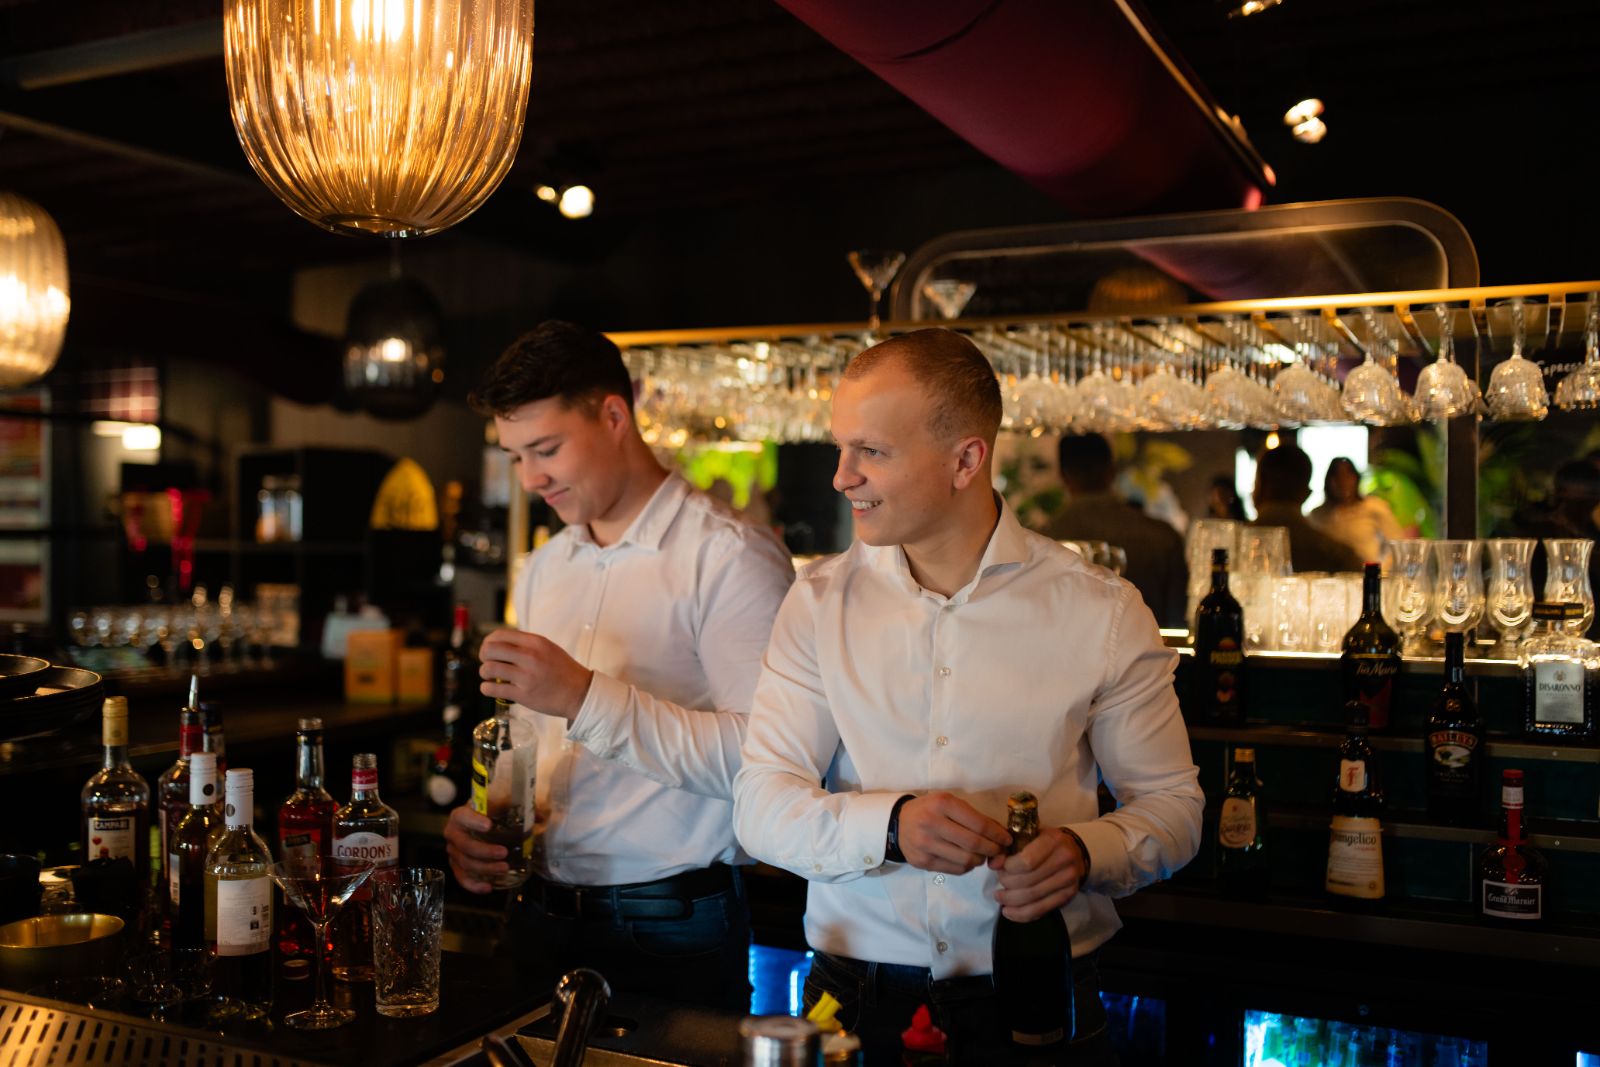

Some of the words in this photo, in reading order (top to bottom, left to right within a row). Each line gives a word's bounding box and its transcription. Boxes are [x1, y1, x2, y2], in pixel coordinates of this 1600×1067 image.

[1539, 682, 1581, 693] DISARONNO
[1431, 732, 1475, 747] BAILEYS
[1347, 766, 1360, 787] F
[337, 844, 392, 859] GORDON'S
[1487, 893, 1508, 904] Grand
[1508, 895, 1536, 906] Marnier
